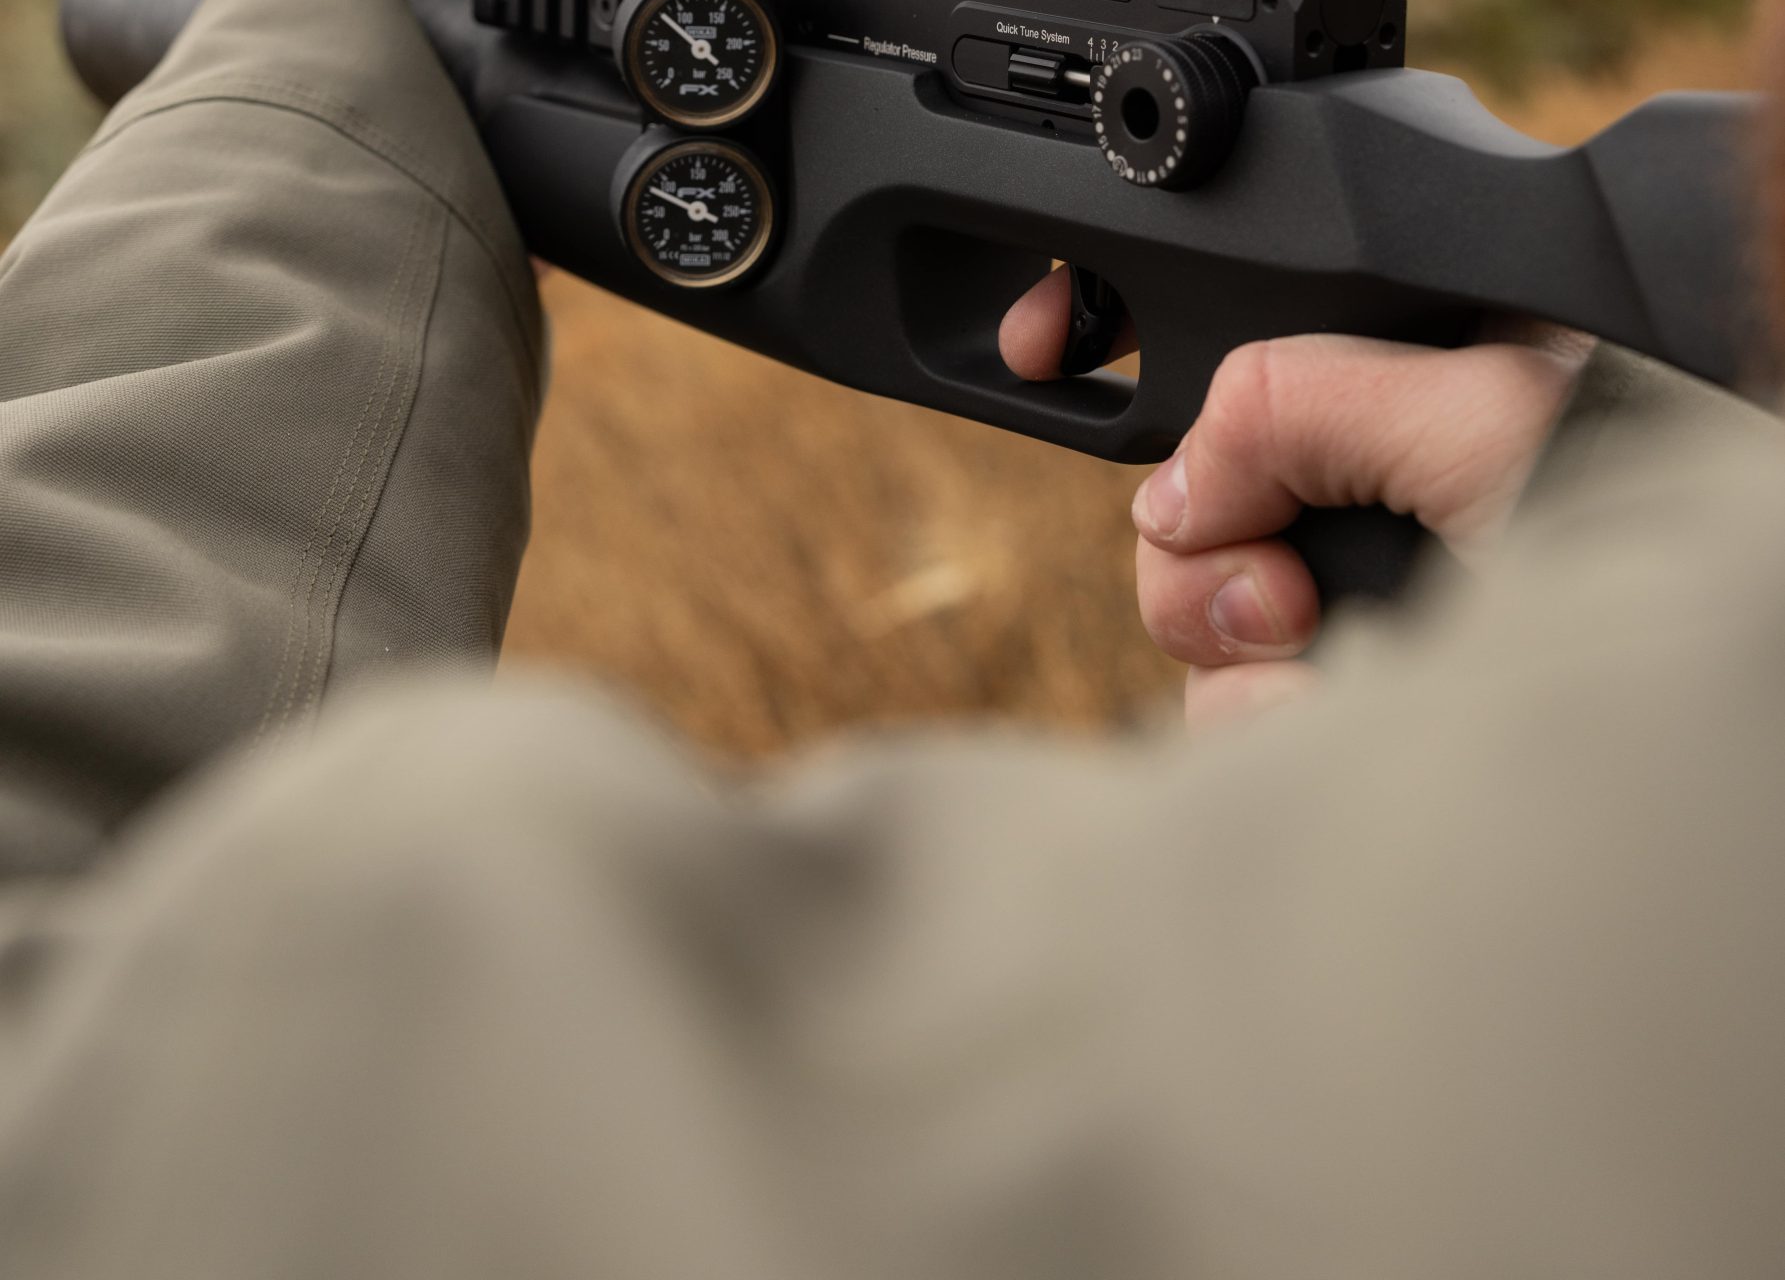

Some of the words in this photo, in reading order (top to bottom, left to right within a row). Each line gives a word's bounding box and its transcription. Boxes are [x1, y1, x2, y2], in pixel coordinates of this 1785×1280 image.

[677, 12, 693, 24] 100
[709, 12, 725, 24] 150
[996, 21, 1018, 35] Quick
[1020, 25, 1039, 39] Tune
[1041, 29, 1070, 45] System
[658, 39, 670, 52] 50
[725, 38, 743, 50] 200
[864, 36, 901, 56] Regulator
[902, 44, 937, 63] Pressure
[1088, 37, 1094, 47] 4
[1101, 39, 1107, 50] 3
[1112, 41, 1119, 52] 2
[668, 67, 675, 79] 0
[692, 68, 706, 79] bar
[716, 67, 733, 80] 250
[679, 84, 719, 95] FX
[690, 168, 706, 180] 150
[661, 181, 676, 193] 100
[677, 187, 716, 199] FX
[718, 182, 735, 193] 200
[653, 206, 665, 218] 50
[722, 205, 739, 218] 250
[663, 228, 670, 240] 0
[689, 232, 702, 242] bar
[712, 229, 728, 242] 300
